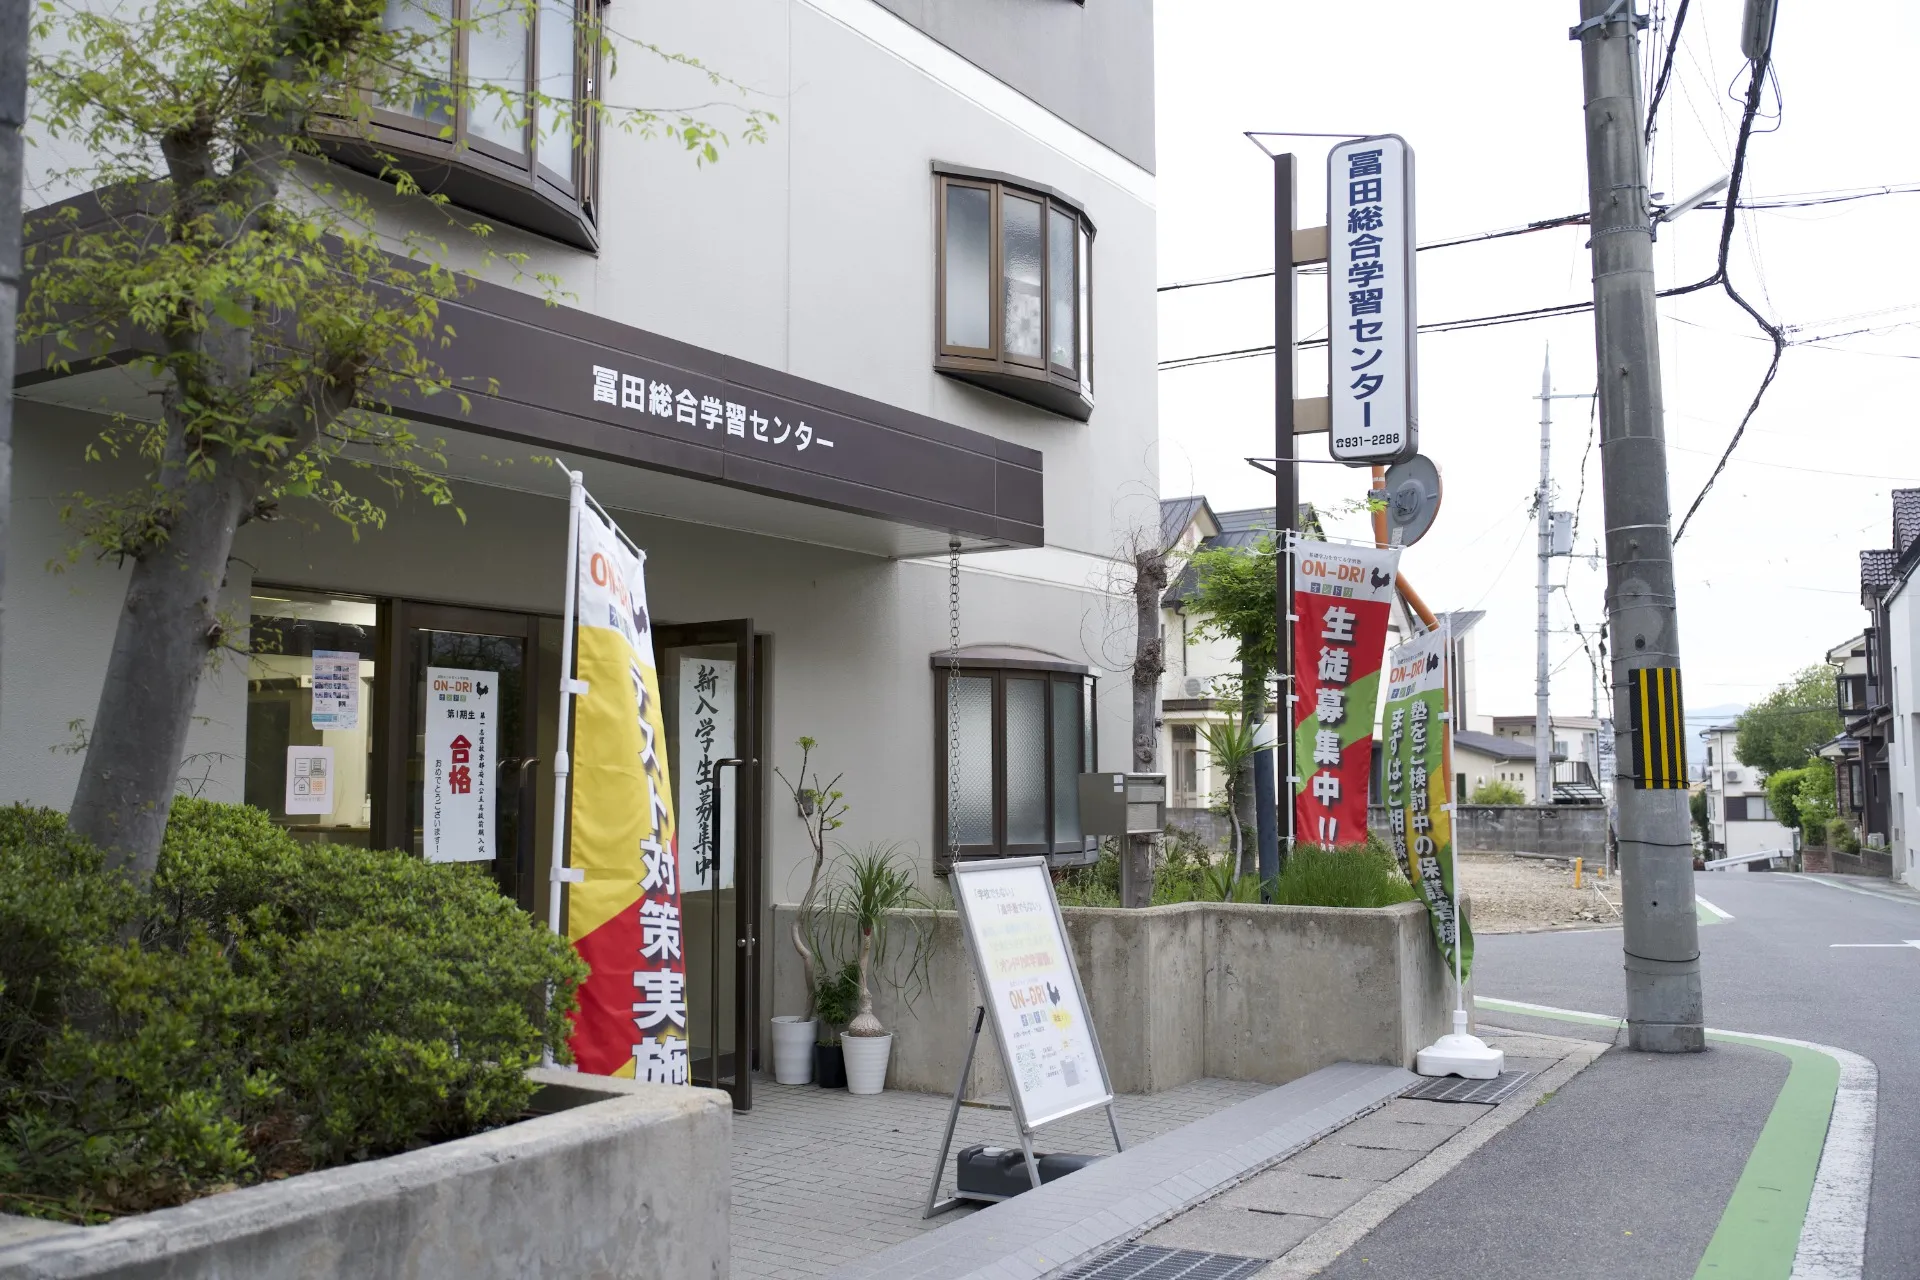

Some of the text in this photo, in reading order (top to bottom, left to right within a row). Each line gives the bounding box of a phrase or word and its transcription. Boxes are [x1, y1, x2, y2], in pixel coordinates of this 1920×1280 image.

[1345, 432, 1400, 448] 931-2288
[1301, 559, 1365, 584] ON-DRI
[1390, 657, 1426, 684] ON-DRI
[433, 679, 473, 693] ON-DRI
[446, 708, 476, 720] 第1期生
[448, 734, 473, 795] 合格
[1009, 984, 1048, 1010] ON-DRI
